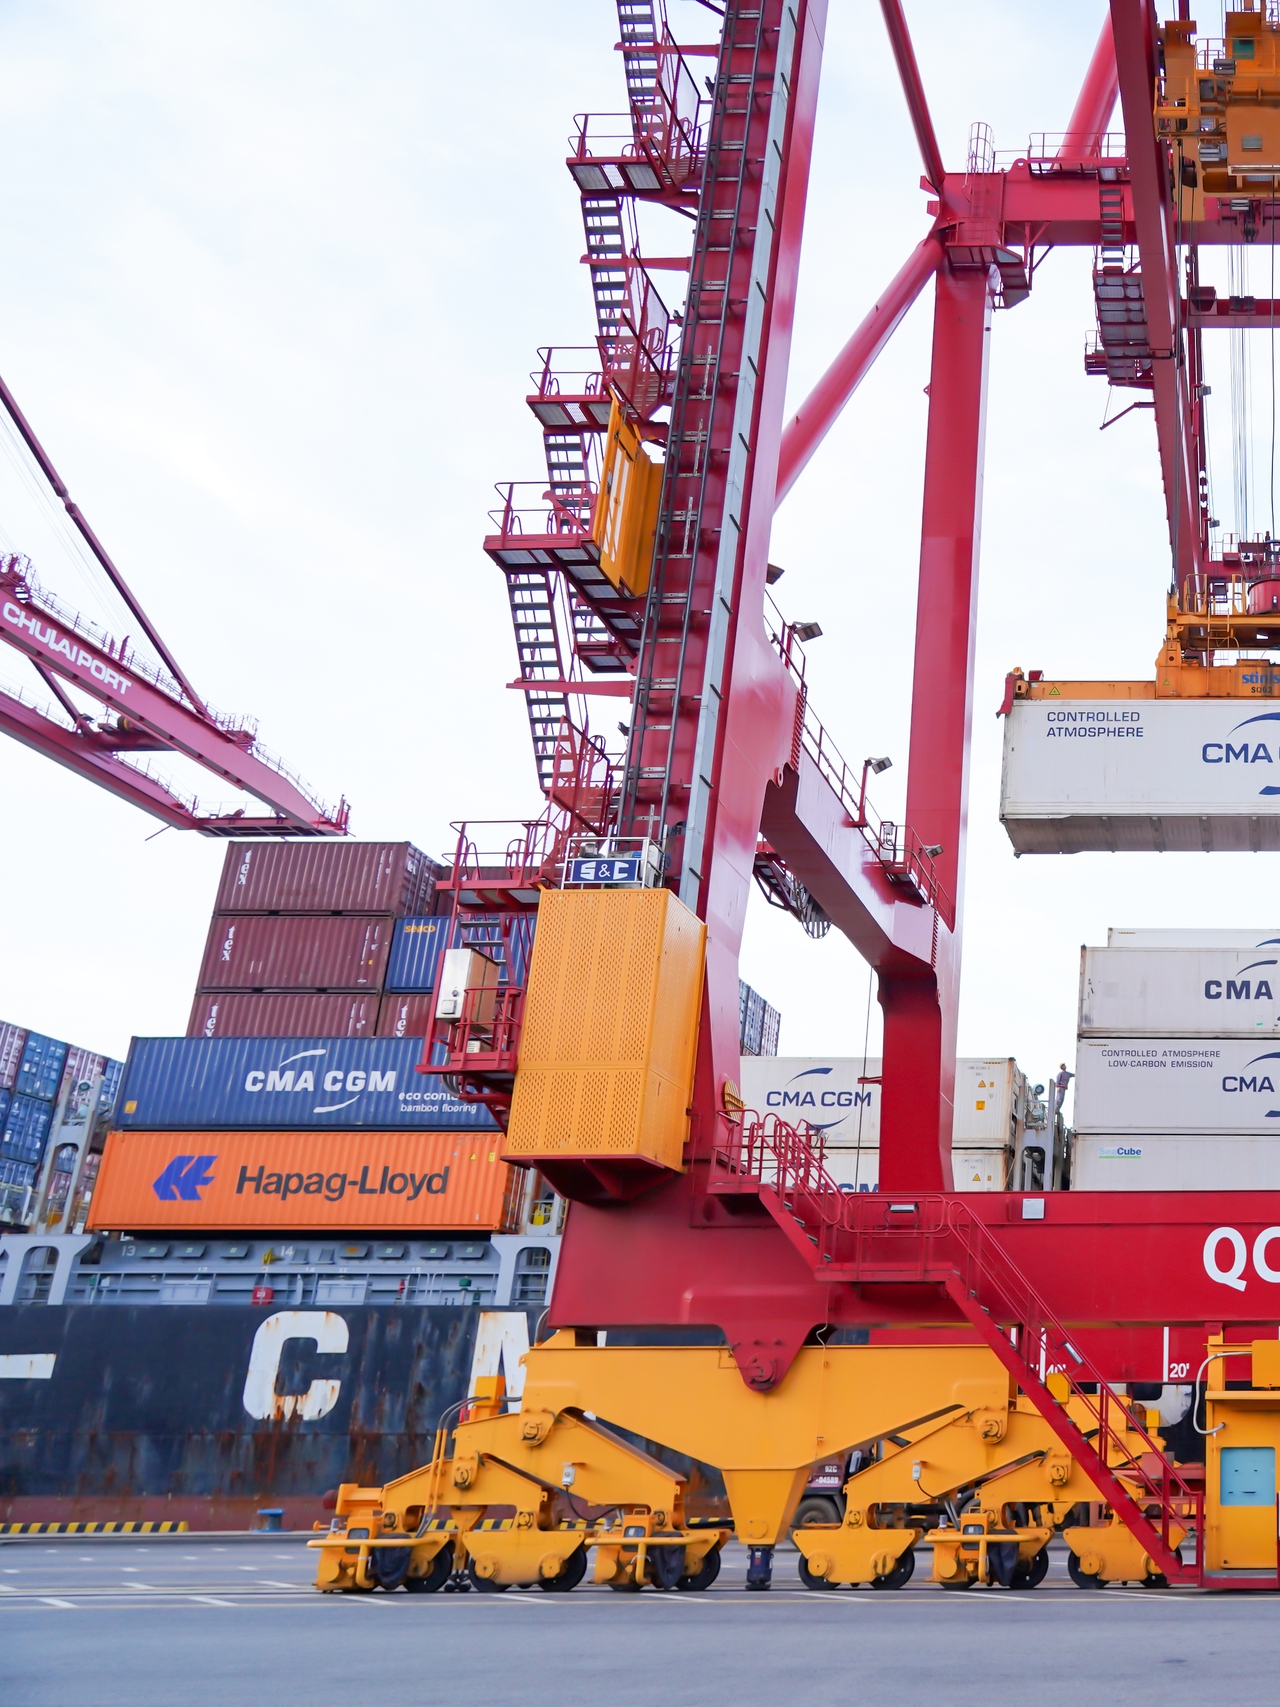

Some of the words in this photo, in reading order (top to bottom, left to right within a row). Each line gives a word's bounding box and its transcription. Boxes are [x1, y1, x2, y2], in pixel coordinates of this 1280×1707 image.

[2, 601, 78, 662] CHULAI
[76, 649, 132, 695] PORT
[1047, 711, 1140, 722] CONTROLLED
[1046, 726, 1144, 738] ATMOSPHERE
[1201, 743, 1274, 764] CMA
[579, 861, 629, 881] S&C
[404, 925, 436, 933] seaco
[1204, 979, 1274, 1001] CMA
[1101, 1050, 1158, 1058] CONTROLLED
[1161, 1050, 1221, 1058] ATMOSPHERE
[1108, 1060, 1167, 1068] LOW-CARBON
[1170, 1060, 1213, 1068] EMISSION
[245, 1070, 315, 1092] CMA
[323, 1070, 397, 1092] CGM
[1222, 1076, 1275, 1093] CMA
[398, 1092, 422, 1100] eco
[766, 1091, 816, 1107] CMA
[820, 1091, 872, 1107] CGM
[400, 1103, 439, 1112] bamboo
[441, 1103, 477, 1114] flooring
[1098, 1147, 1142, 1156] SeaCube
[236, 1165, 450, 1202] Hapag-Lloyd
[121, 1245, 136, 1257] 13
[280, 1245, 294, 1257] 14
[1169, 1363, 1190, 1378] 20'
